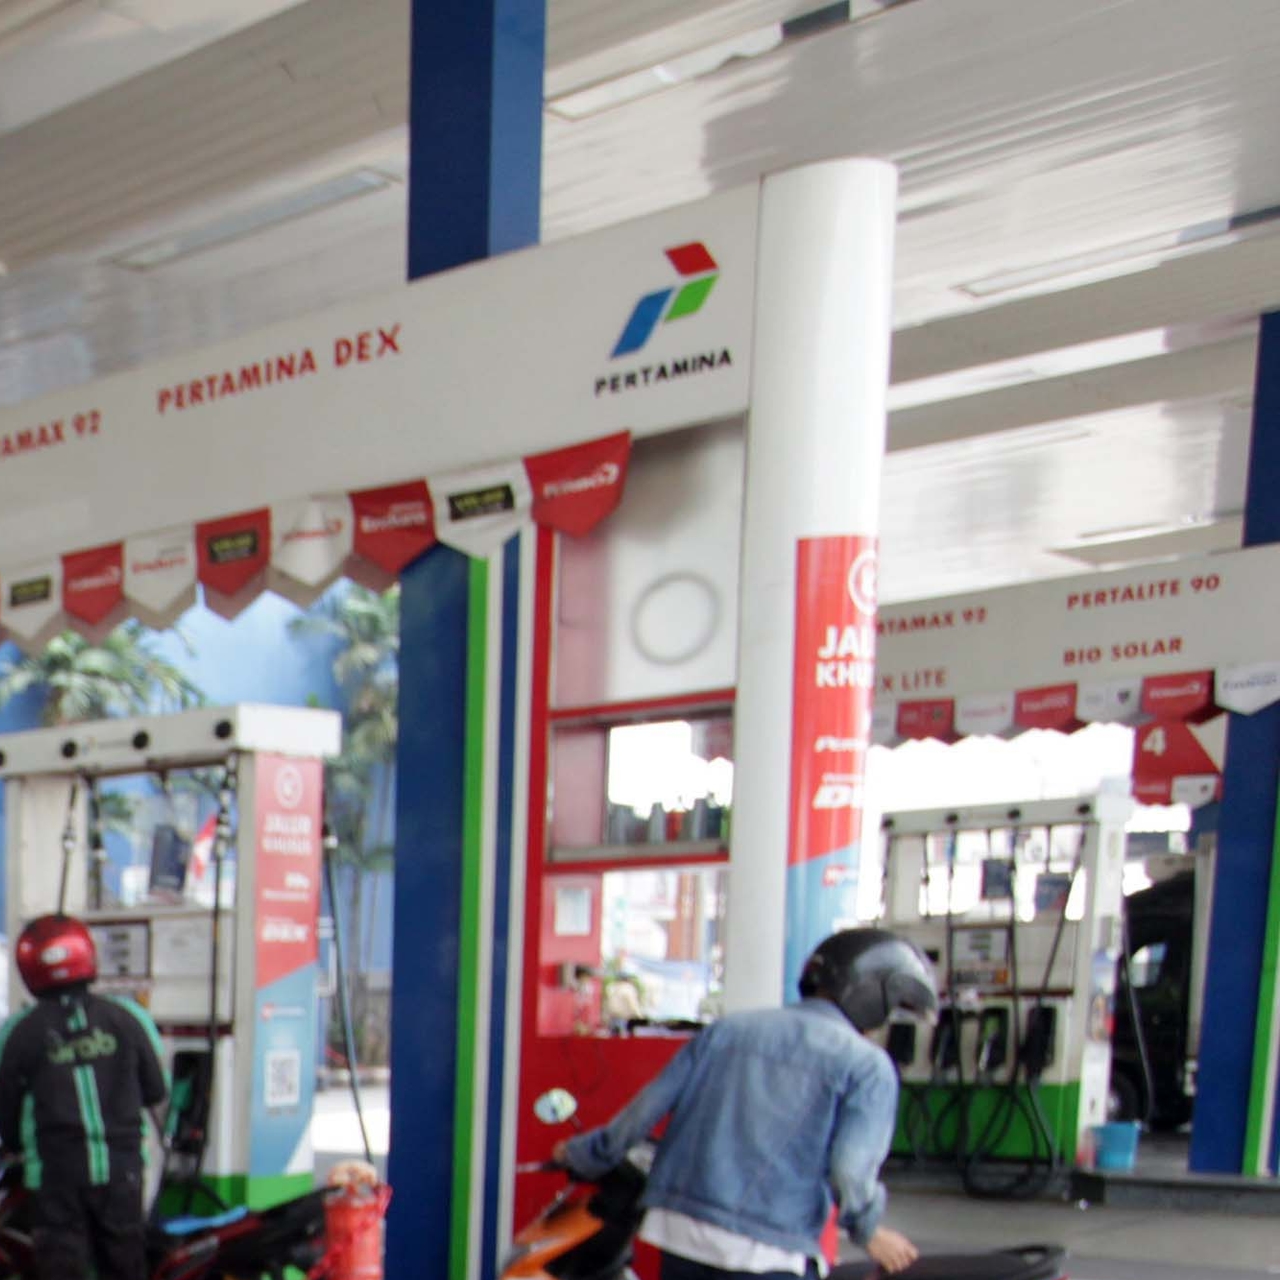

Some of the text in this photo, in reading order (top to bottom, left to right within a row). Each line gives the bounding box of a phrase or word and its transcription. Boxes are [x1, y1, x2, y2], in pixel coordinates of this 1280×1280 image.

[156, 324, 402, 414] PERTAMINA DEX
[594, 349, 733, 395] PERTAMINA
[73, 409, 102, 435] 92
[1066, 573, 1220, 610] PERTALITE 90
[962, 606, 987, 624] 92
[1063, 637, 1183, 667] BIO SOLAR
[1142, 726, 1167, 756] 4
